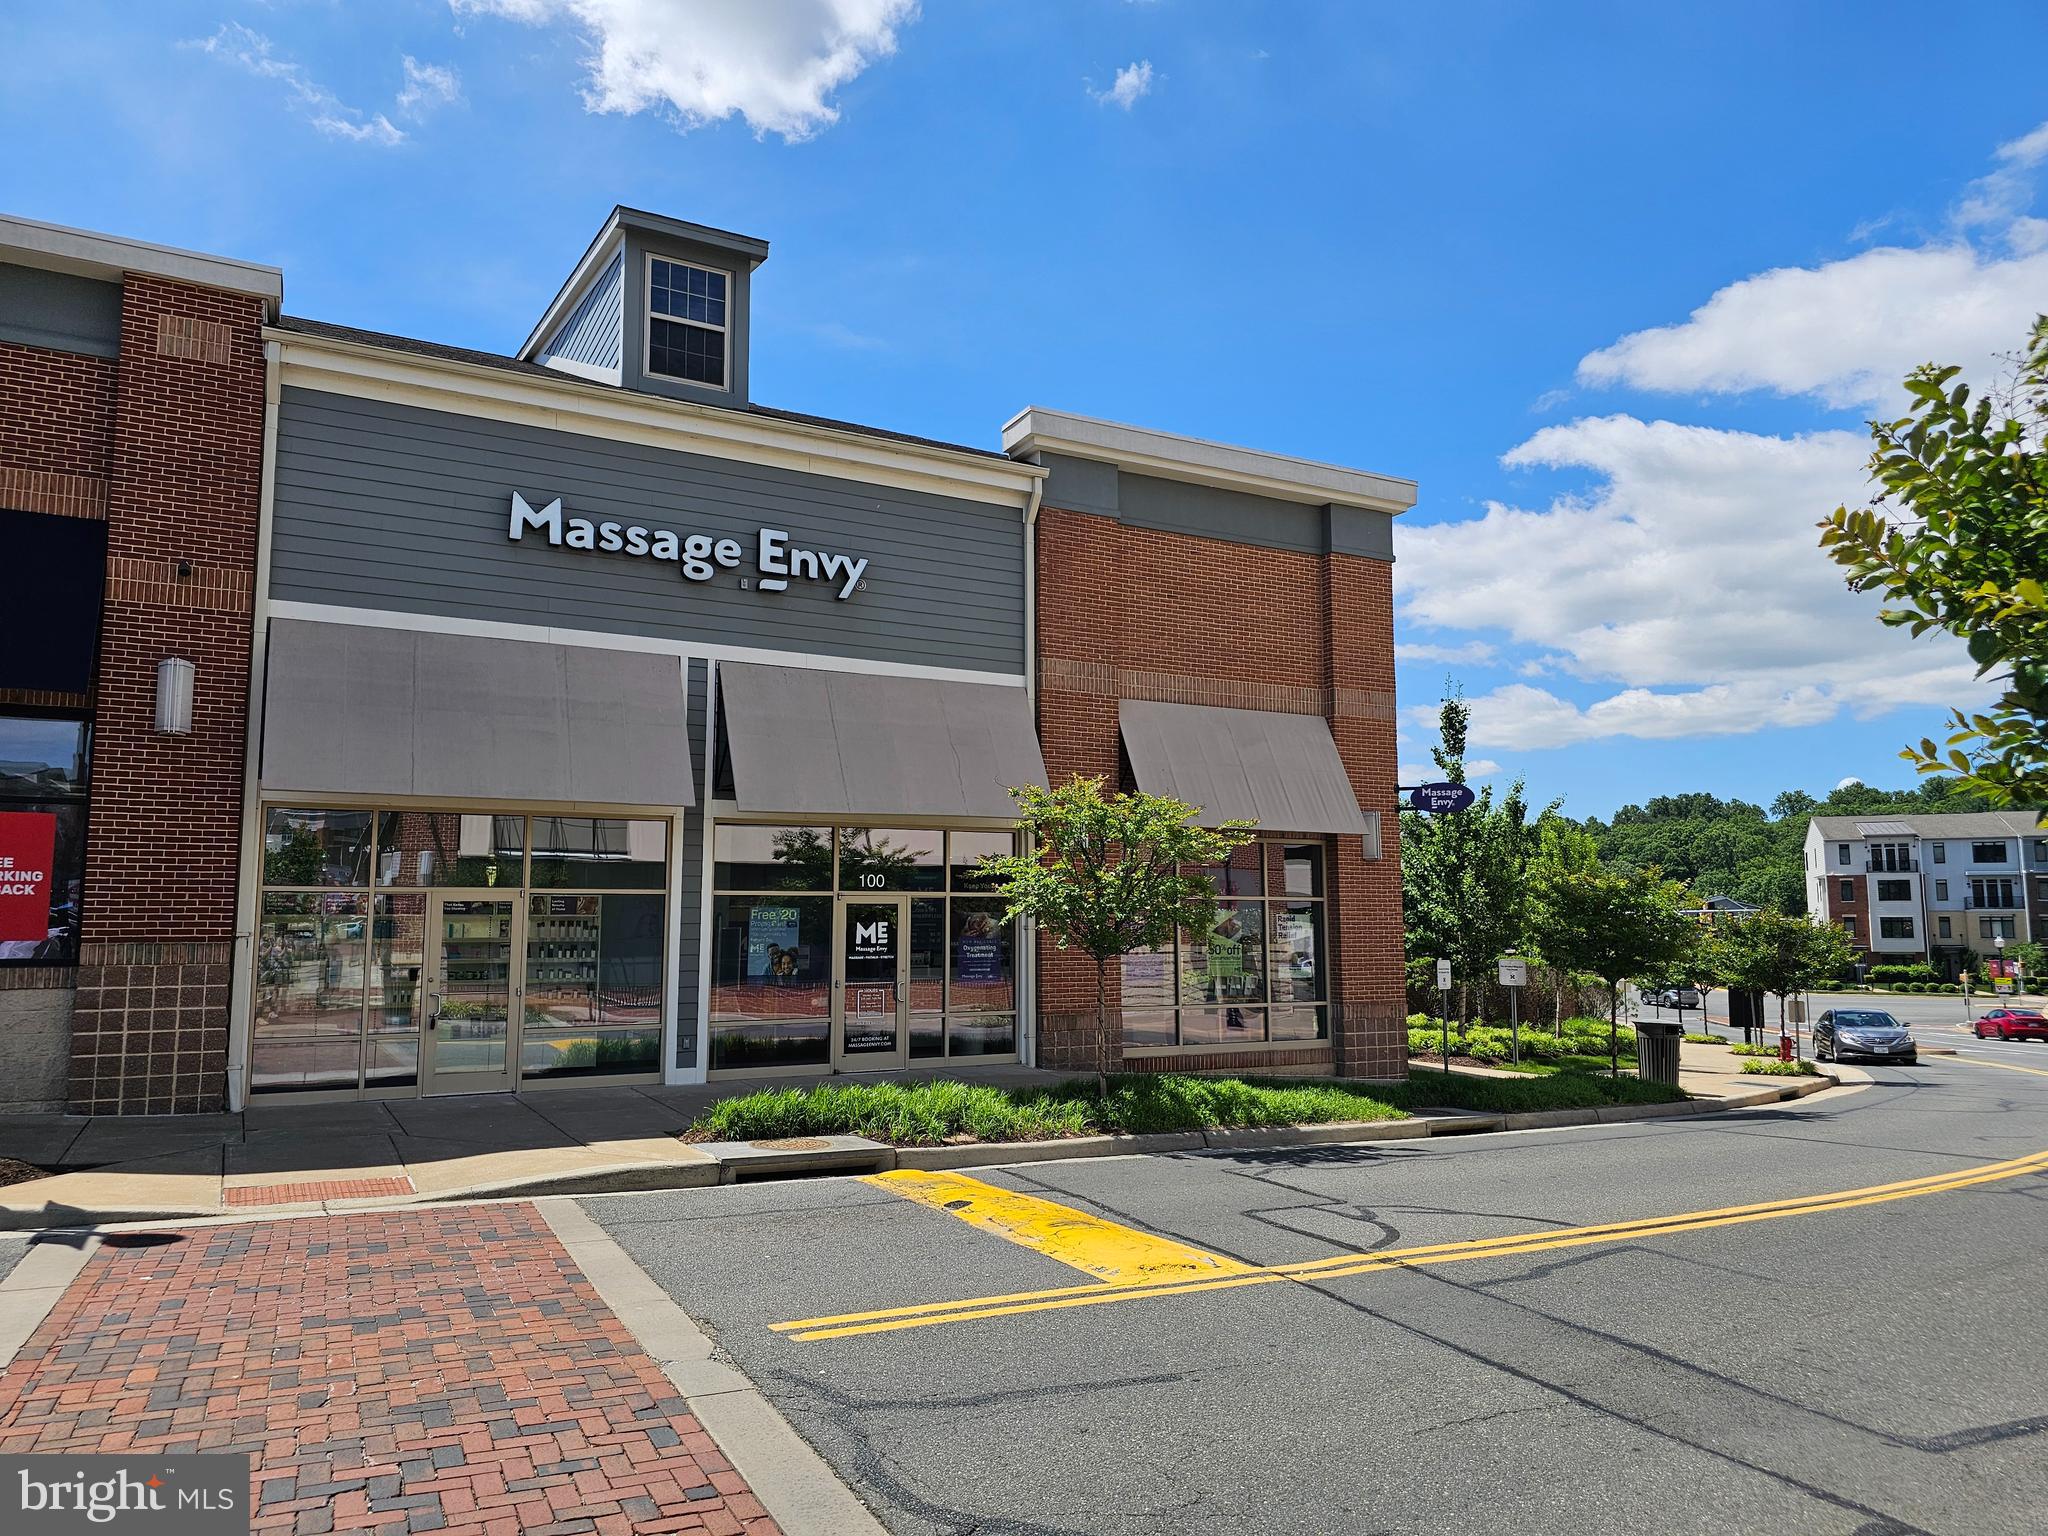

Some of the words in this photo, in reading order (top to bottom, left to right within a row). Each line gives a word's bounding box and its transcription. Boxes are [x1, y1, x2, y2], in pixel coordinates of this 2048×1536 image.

[509, 490, 742, 581] Massage
[1421, 788, 1463, 799] Massage
[859, 874, 885, 888] 100
[0, 884, 36, 895] ACK
[751, 909, 776, 920] Free
[1278, 915, 1295, 923] Rapid
[855, 921, 889, 945] ME
[876, 945, 888, 953] Envy
[1227, 944, 1241, 955] off
